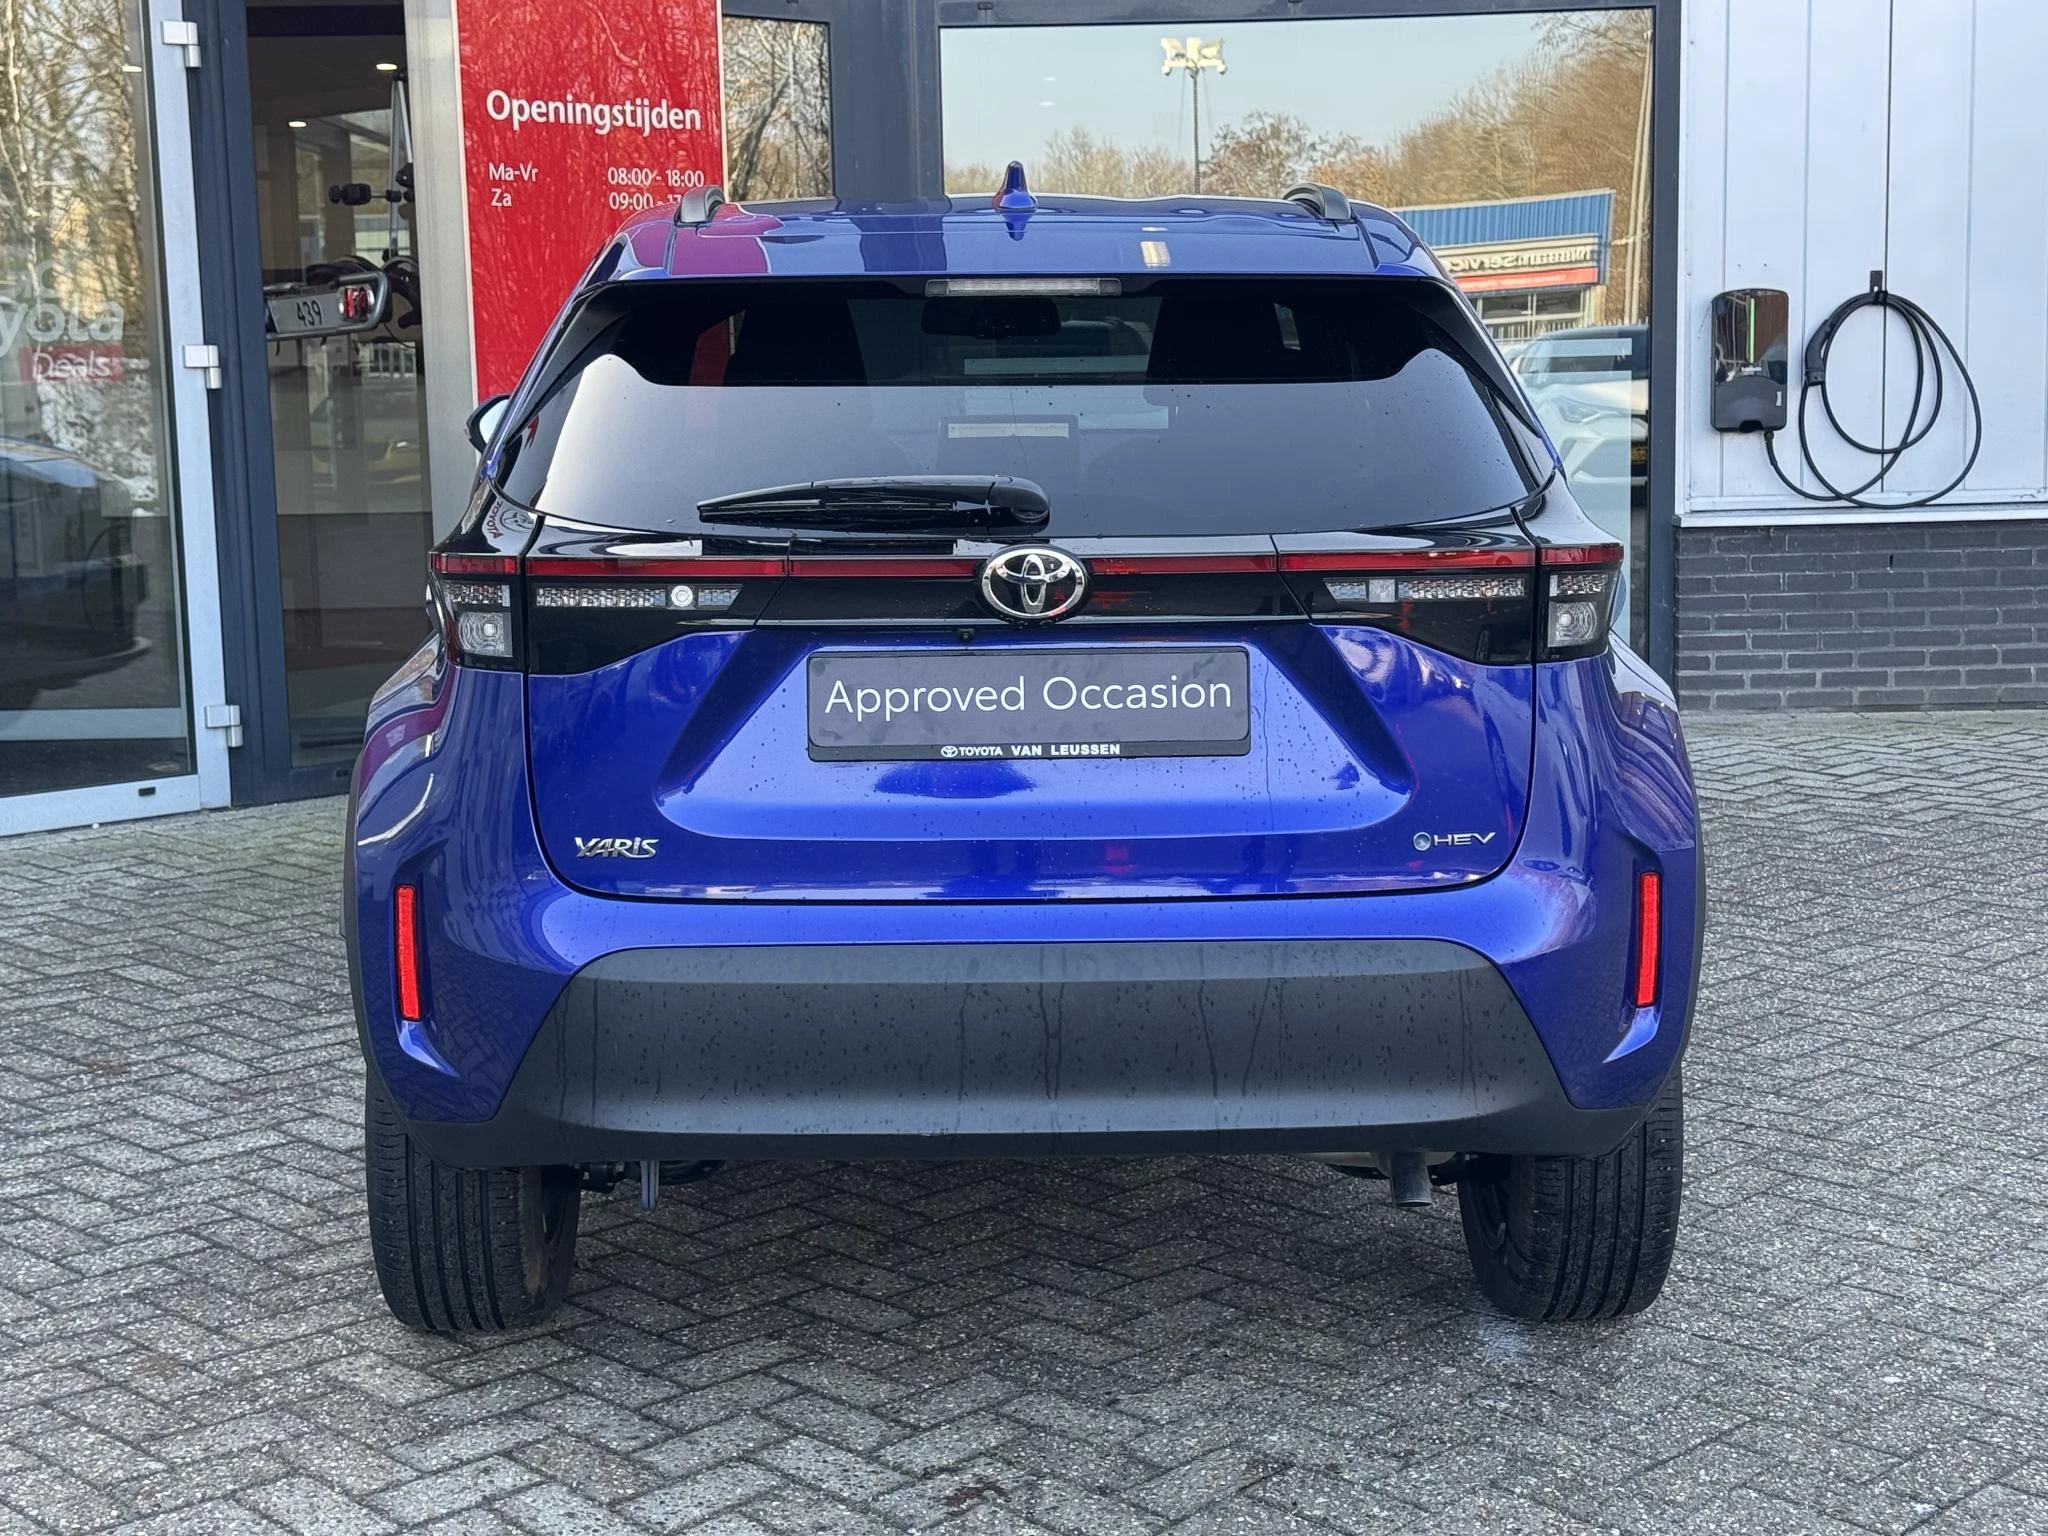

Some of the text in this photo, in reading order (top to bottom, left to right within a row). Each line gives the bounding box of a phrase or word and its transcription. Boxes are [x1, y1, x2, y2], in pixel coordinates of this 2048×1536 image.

[486, 89, 701, 136] Openingstijden
[489, 161, 538, 182] Ma-Vr
[607, 167, 651, 186] 08:00
[665, 169, 705, 188] 18:00
[491, 188, 512, 207] Za
[609, 191, 655, 210] 09:00
[32, 351, 111, 379] Deals
[825, 675, 1232, 722] Approved Occasion
[958, 744, 1120, 756] TOYOTA VAN LEUSSEN
[574, 837, 660, 858] YARIS
[1433, 832, 1496, 846] HEV
